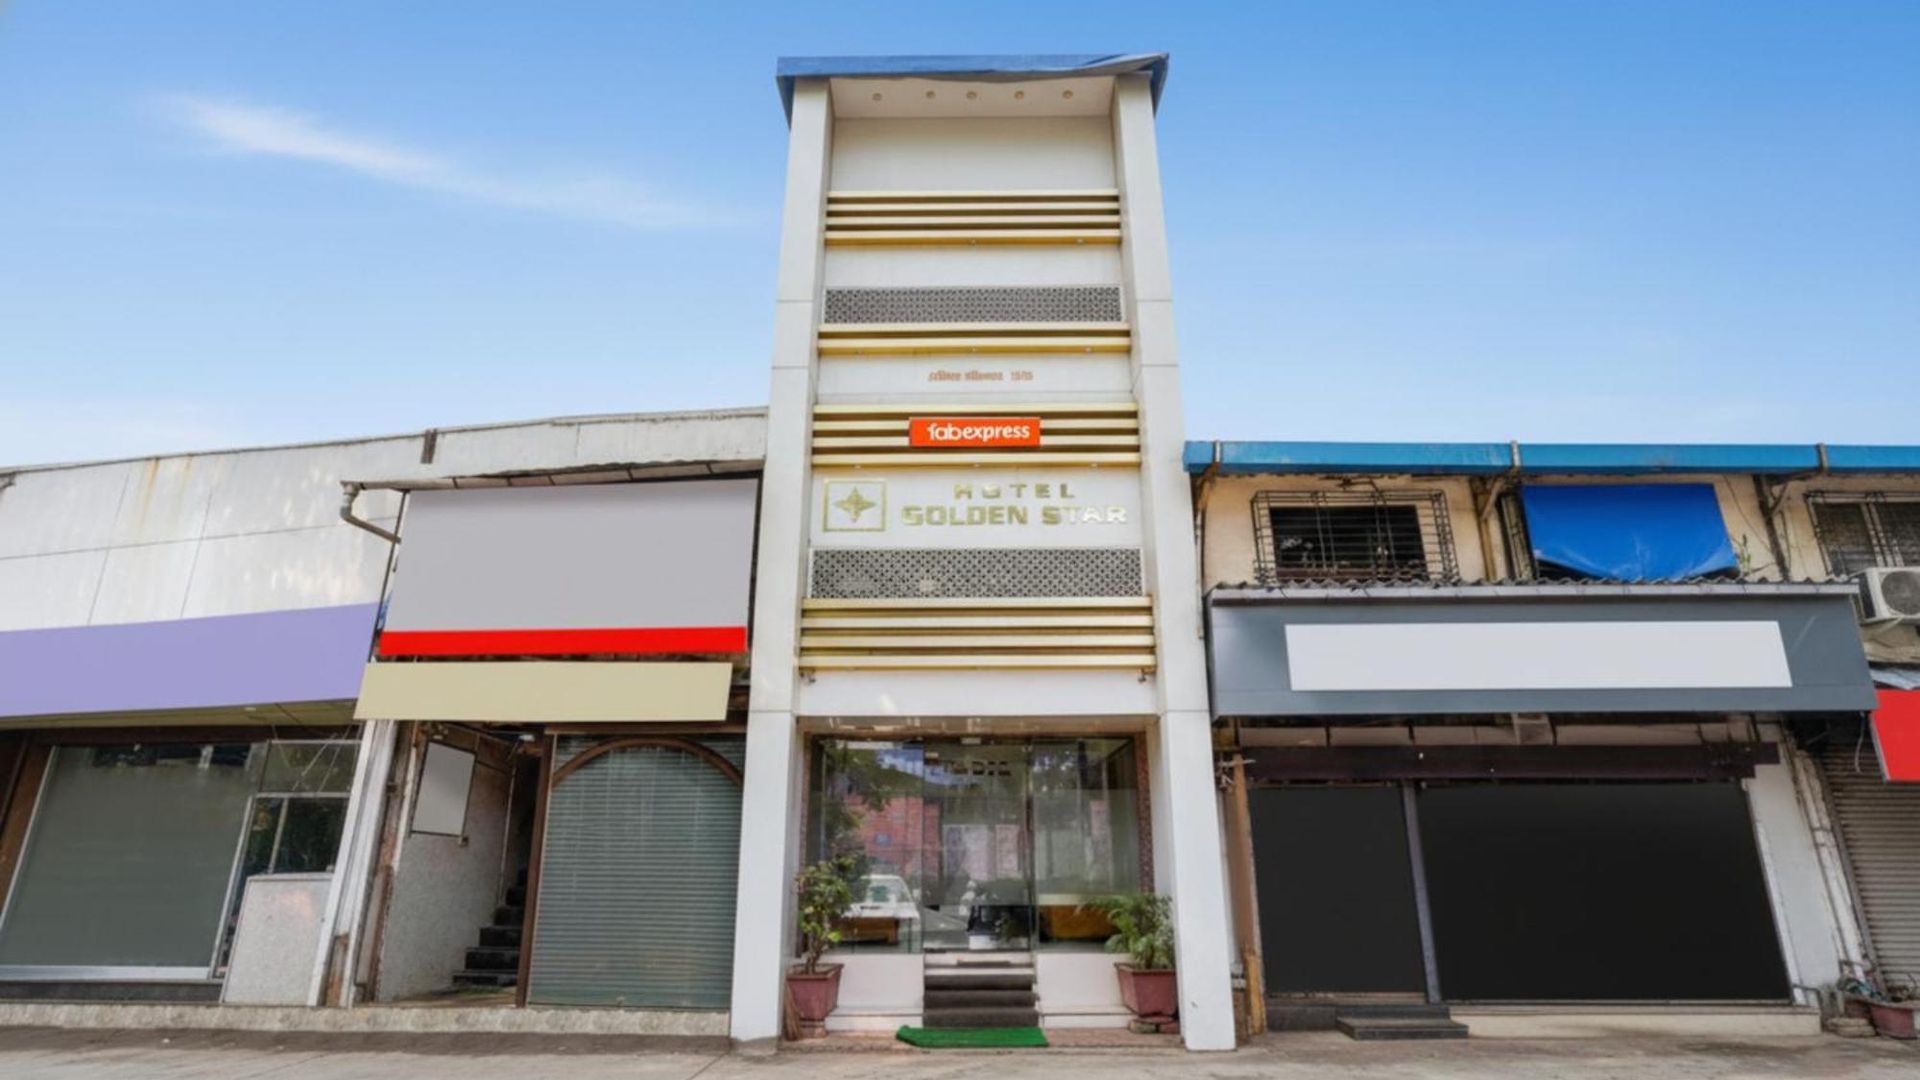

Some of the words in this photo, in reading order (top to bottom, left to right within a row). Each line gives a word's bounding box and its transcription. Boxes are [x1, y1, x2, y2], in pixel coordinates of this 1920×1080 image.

[927, 422, 1030, 442] fabexpress
[953, 483, 1075, 499] HOTEL
[902, 506, 1027, 525] GOLDEN
[1042, 506, 1127, 524] STAR
